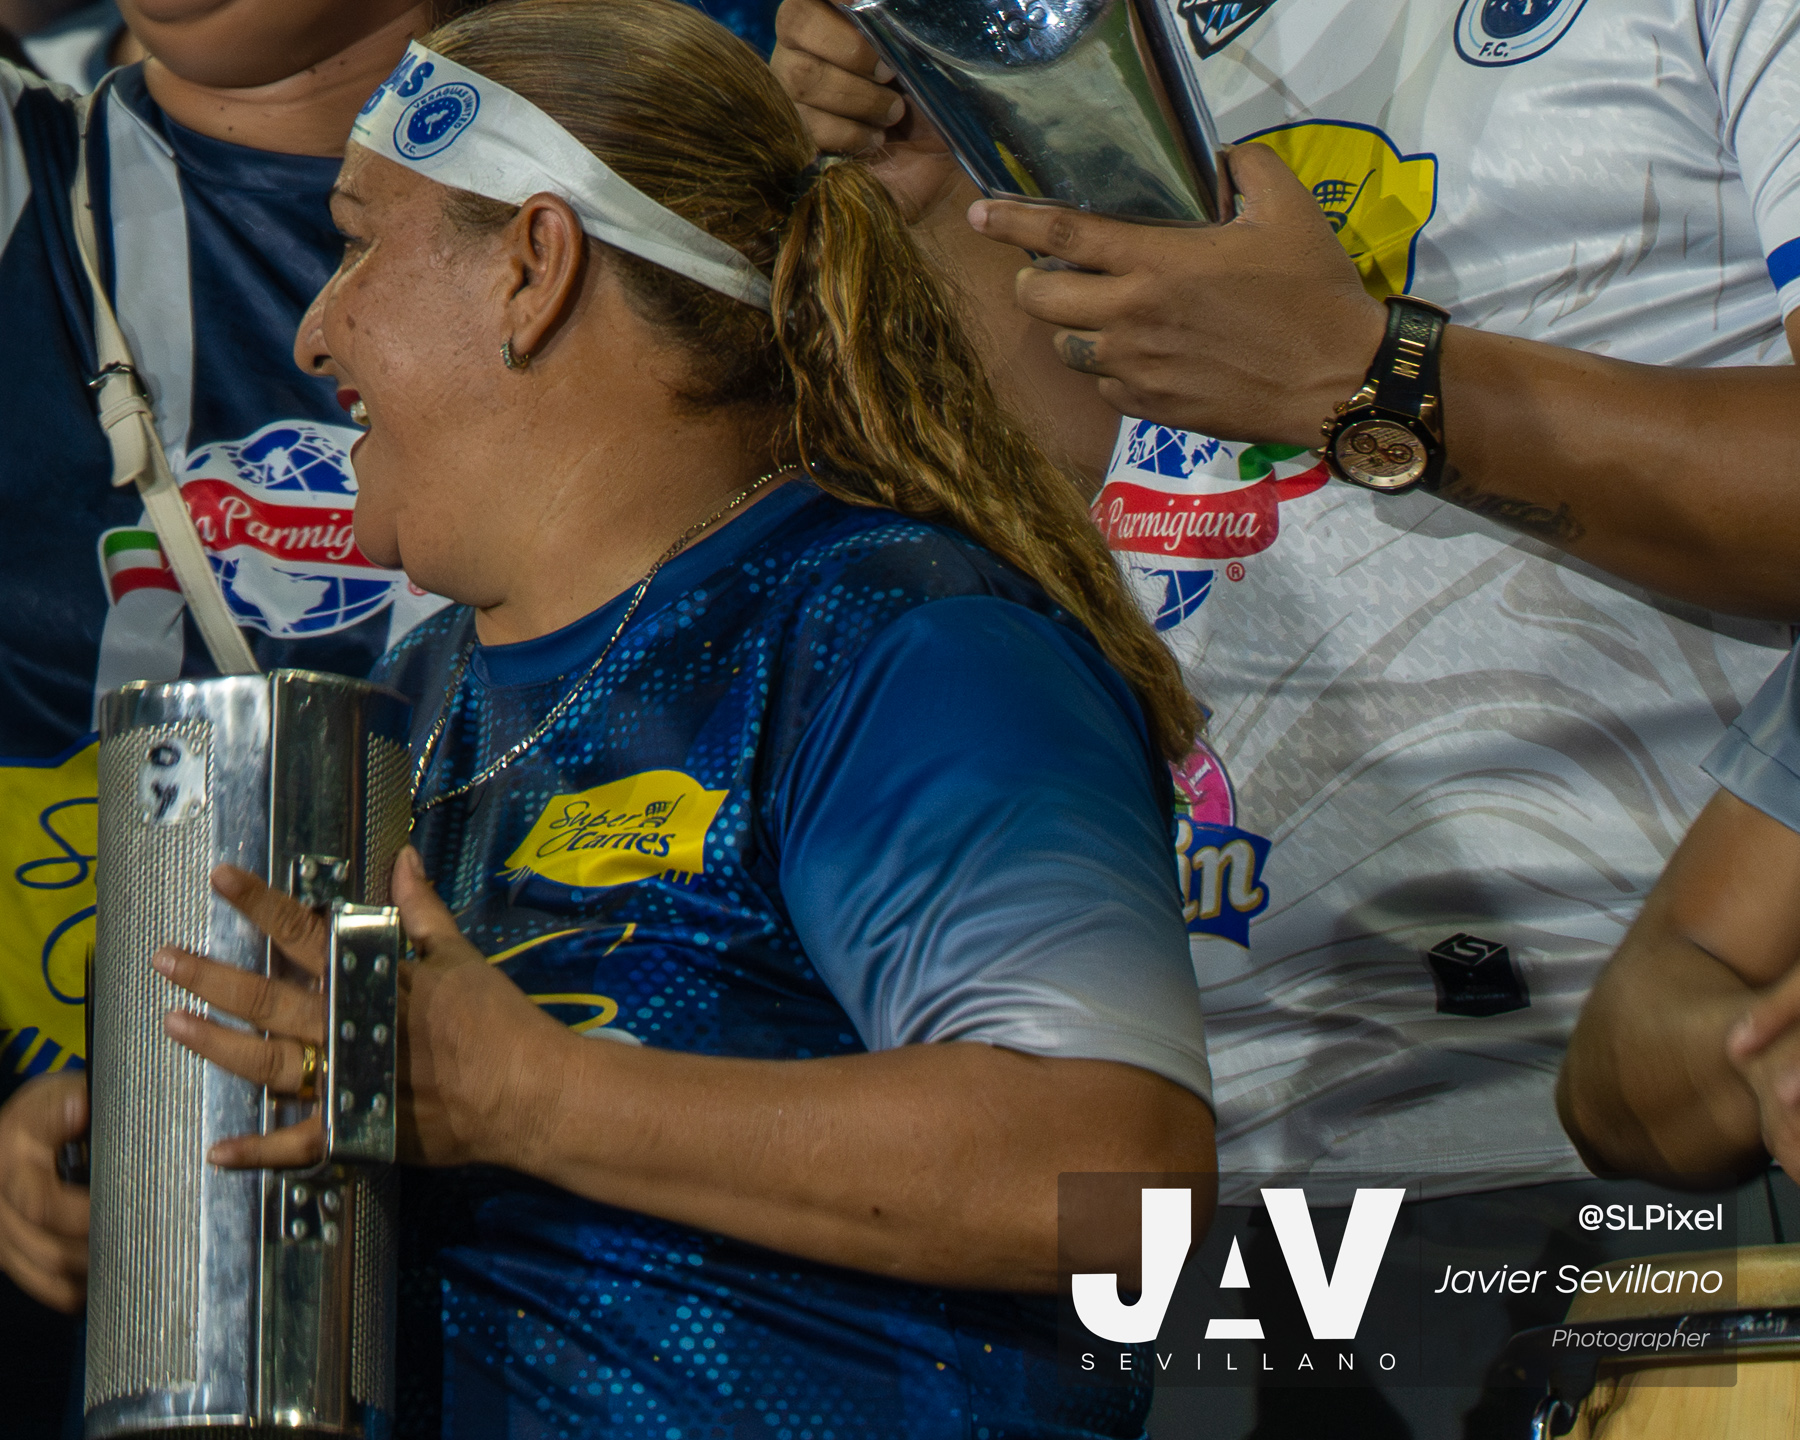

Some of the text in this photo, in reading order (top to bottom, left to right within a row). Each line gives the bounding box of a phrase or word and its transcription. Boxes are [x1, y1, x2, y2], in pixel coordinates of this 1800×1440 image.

[1478, 41, 1509, 57] F.C.
[412, 86, 469, 109] VERAGUAS
[219, 495, 355, 561] Parmig
[1107, 497, 1261, 551] Parmigiana
[537, 801, 643, 859] Super
